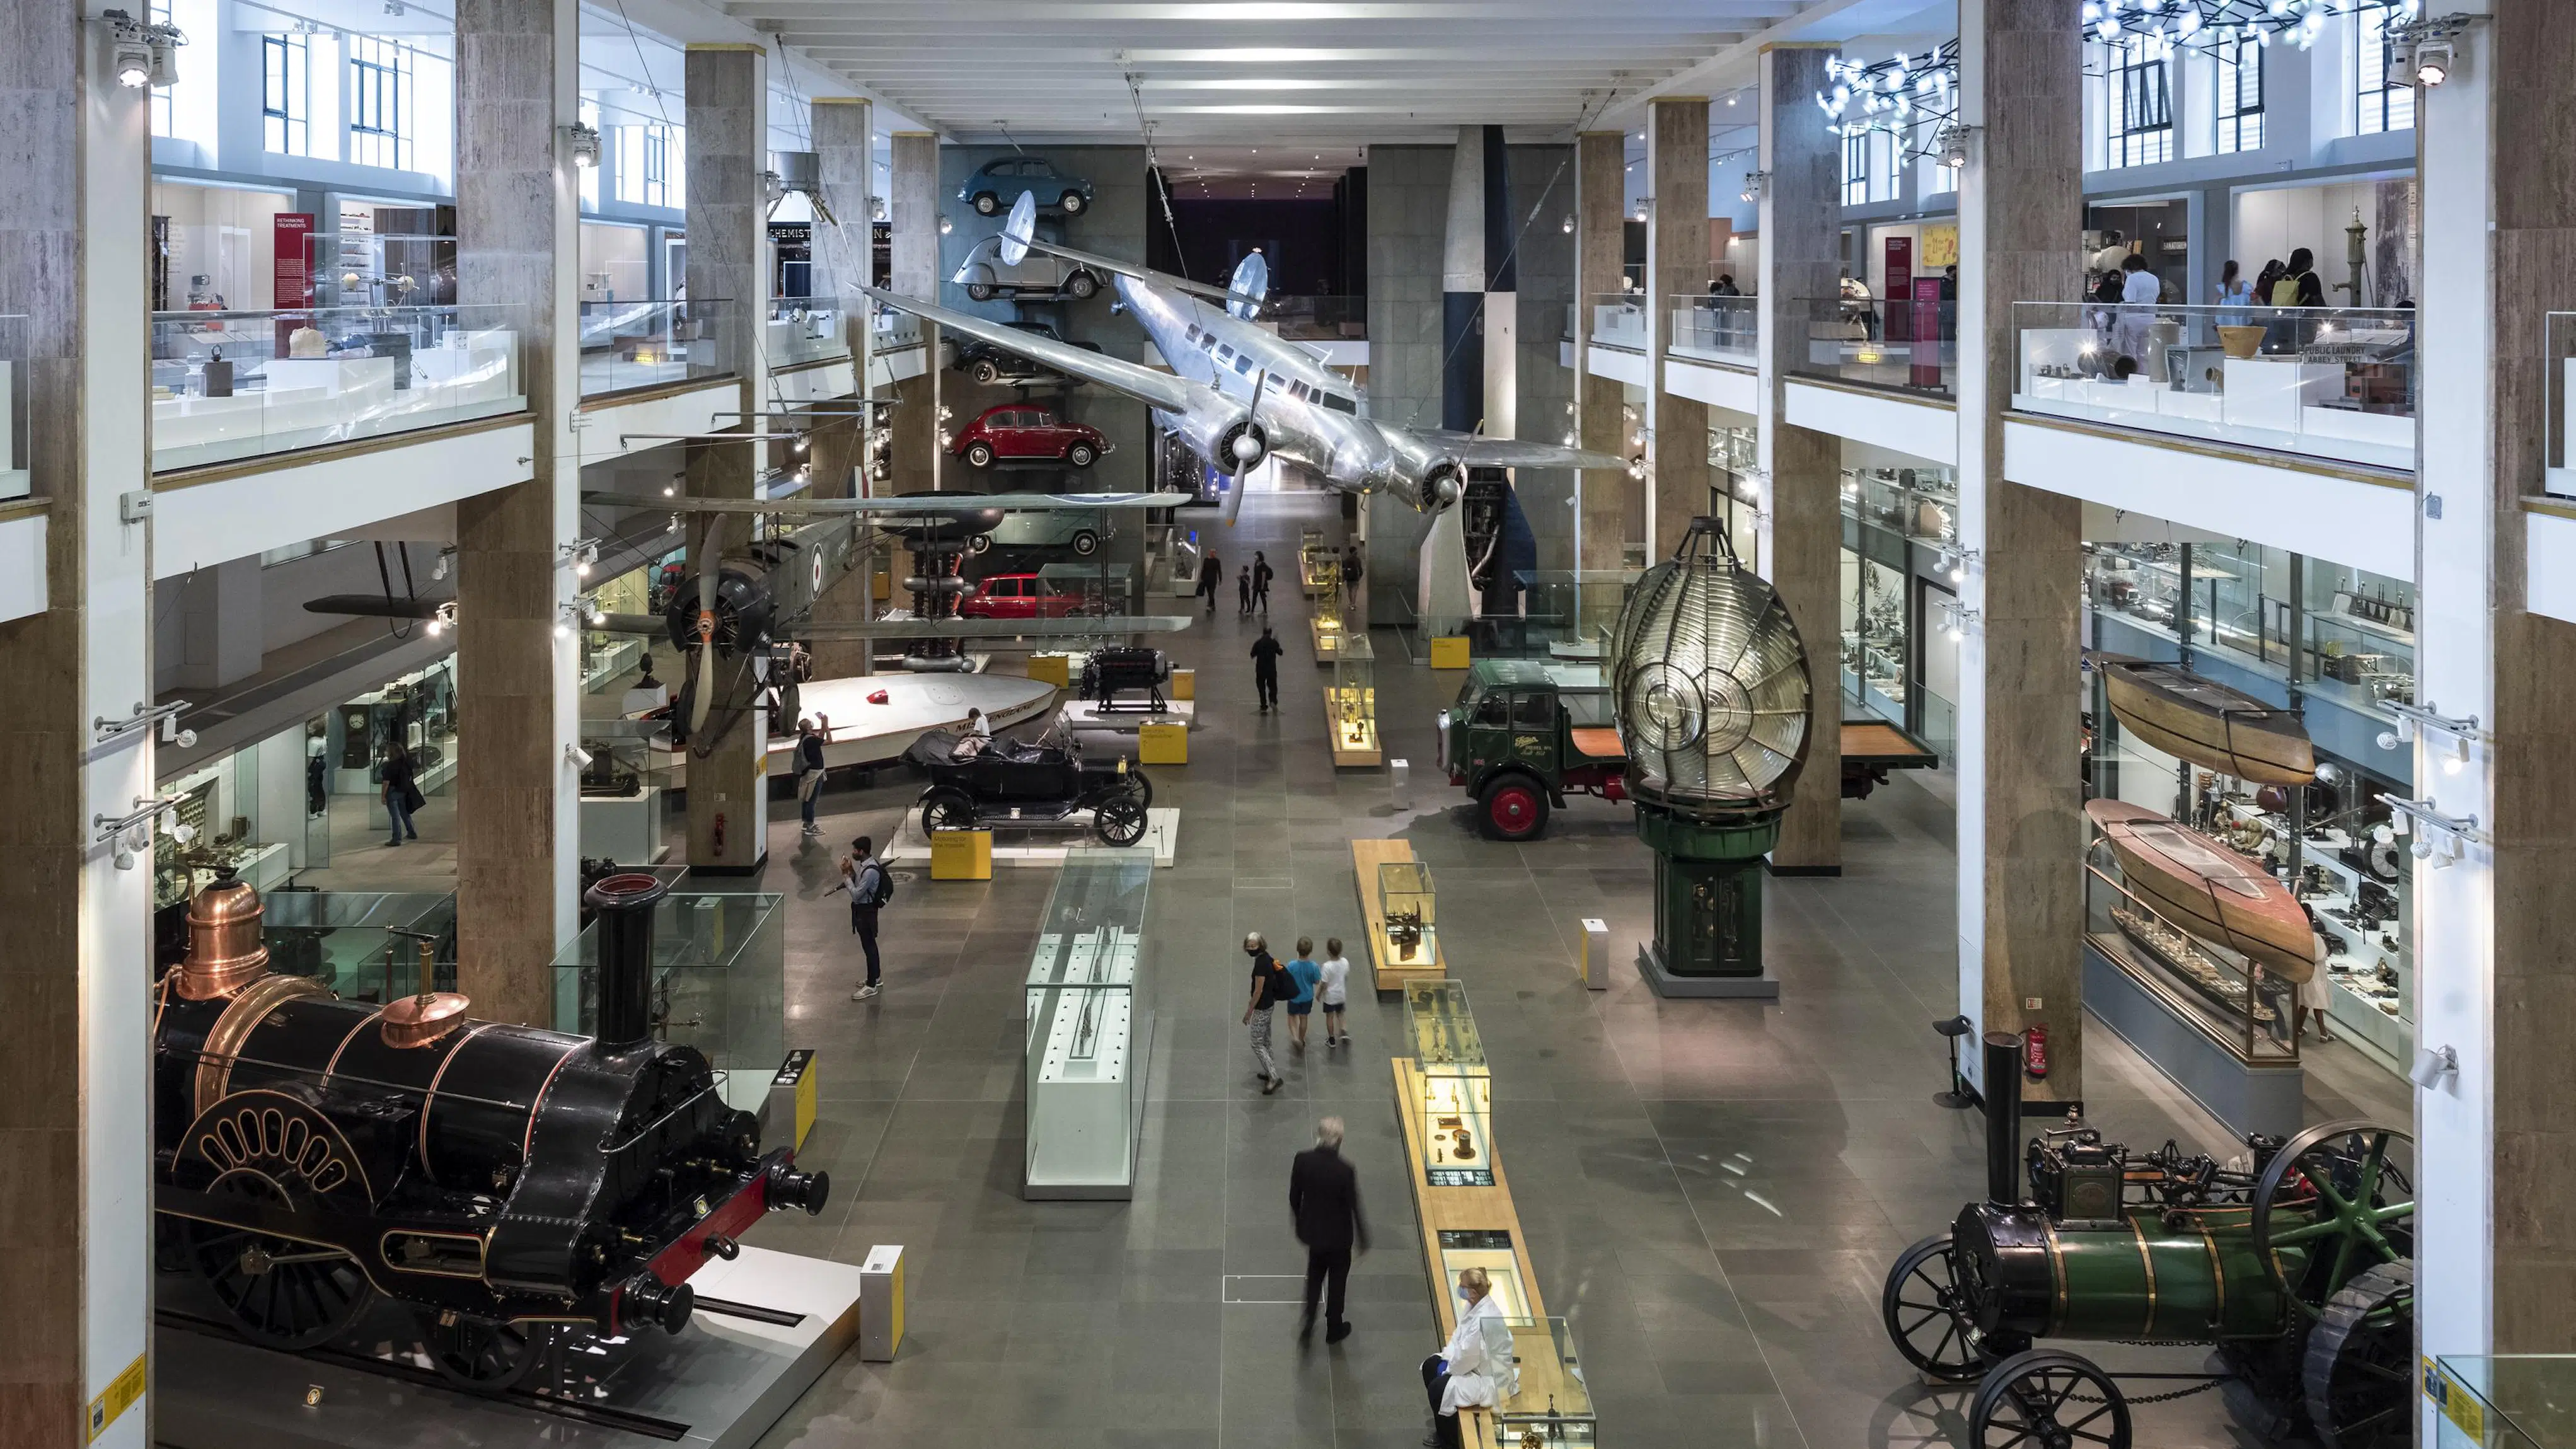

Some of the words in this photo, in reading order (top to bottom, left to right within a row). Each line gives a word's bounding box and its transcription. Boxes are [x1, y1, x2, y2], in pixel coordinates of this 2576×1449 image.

[769, 229, 811, 238] CHEMIST
[2305, 345, 2331, 354] PUBLIC
[2332, 345, 2365, 354] LAUNDRY
[955, 720, 976, 732] MIS
